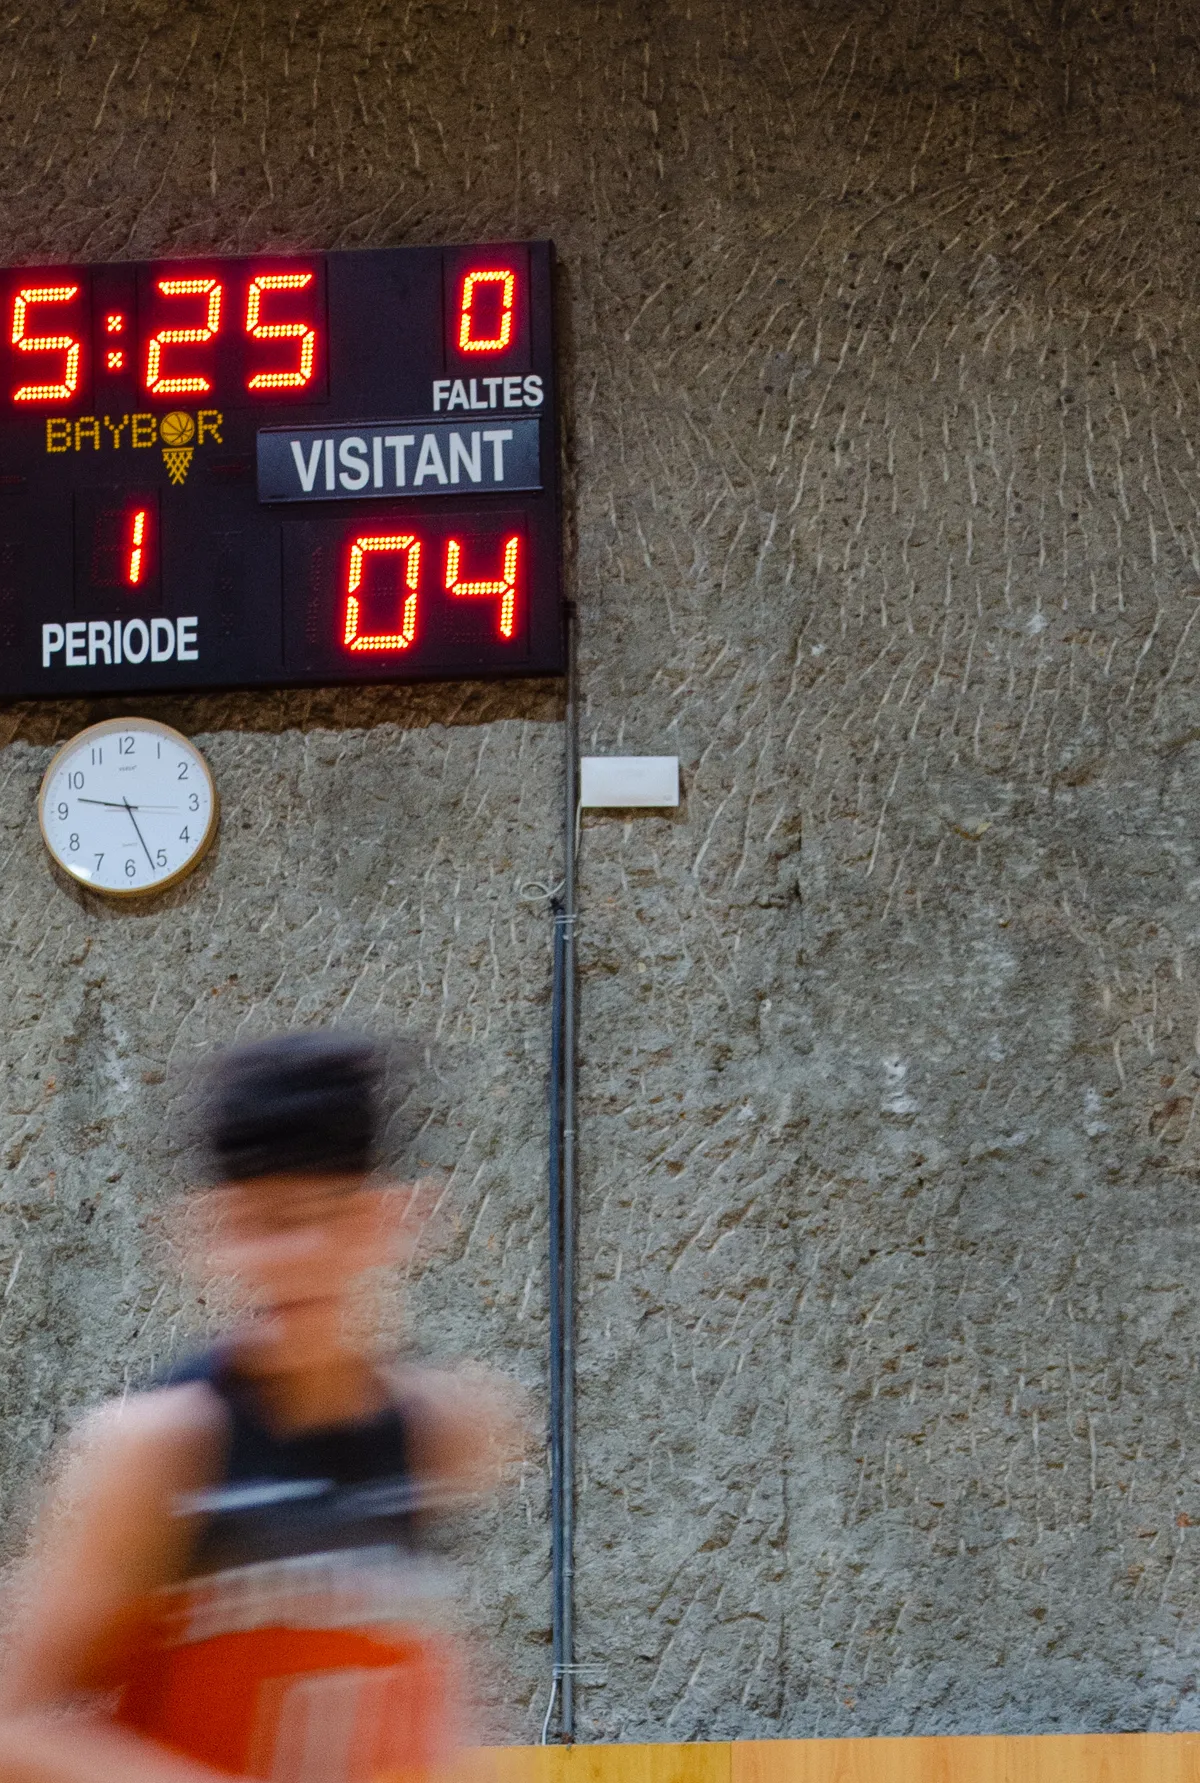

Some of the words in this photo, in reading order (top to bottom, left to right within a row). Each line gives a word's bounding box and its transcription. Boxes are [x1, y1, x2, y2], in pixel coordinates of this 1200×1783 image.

[459, 269, 515, 352] 0
[432, 374, 544, 412] FALTES
[290, 429, 514, 493] VISITANT
[129, 510, 146, 584] 1
[343, 534, 519, 652] 04
[42, 616, 199, 668] PERIODE
[118, 736, 136, 755] 12
[156, 742, 161, 760] 1
[91, 748, 103, 766] 11
[67, 771, 85, 790] 10
[176, 762, 189, 781] 2
[57, 802, 69, 820] 9
[188, 793, 200, 812] 3
[69, 832, 81, 851] 8
[179, 825, 190, 844] 4
[94, 853, 105, 872] 7
[156, 849, 168, 868] 5
[124, 859, 136, 878] 6
